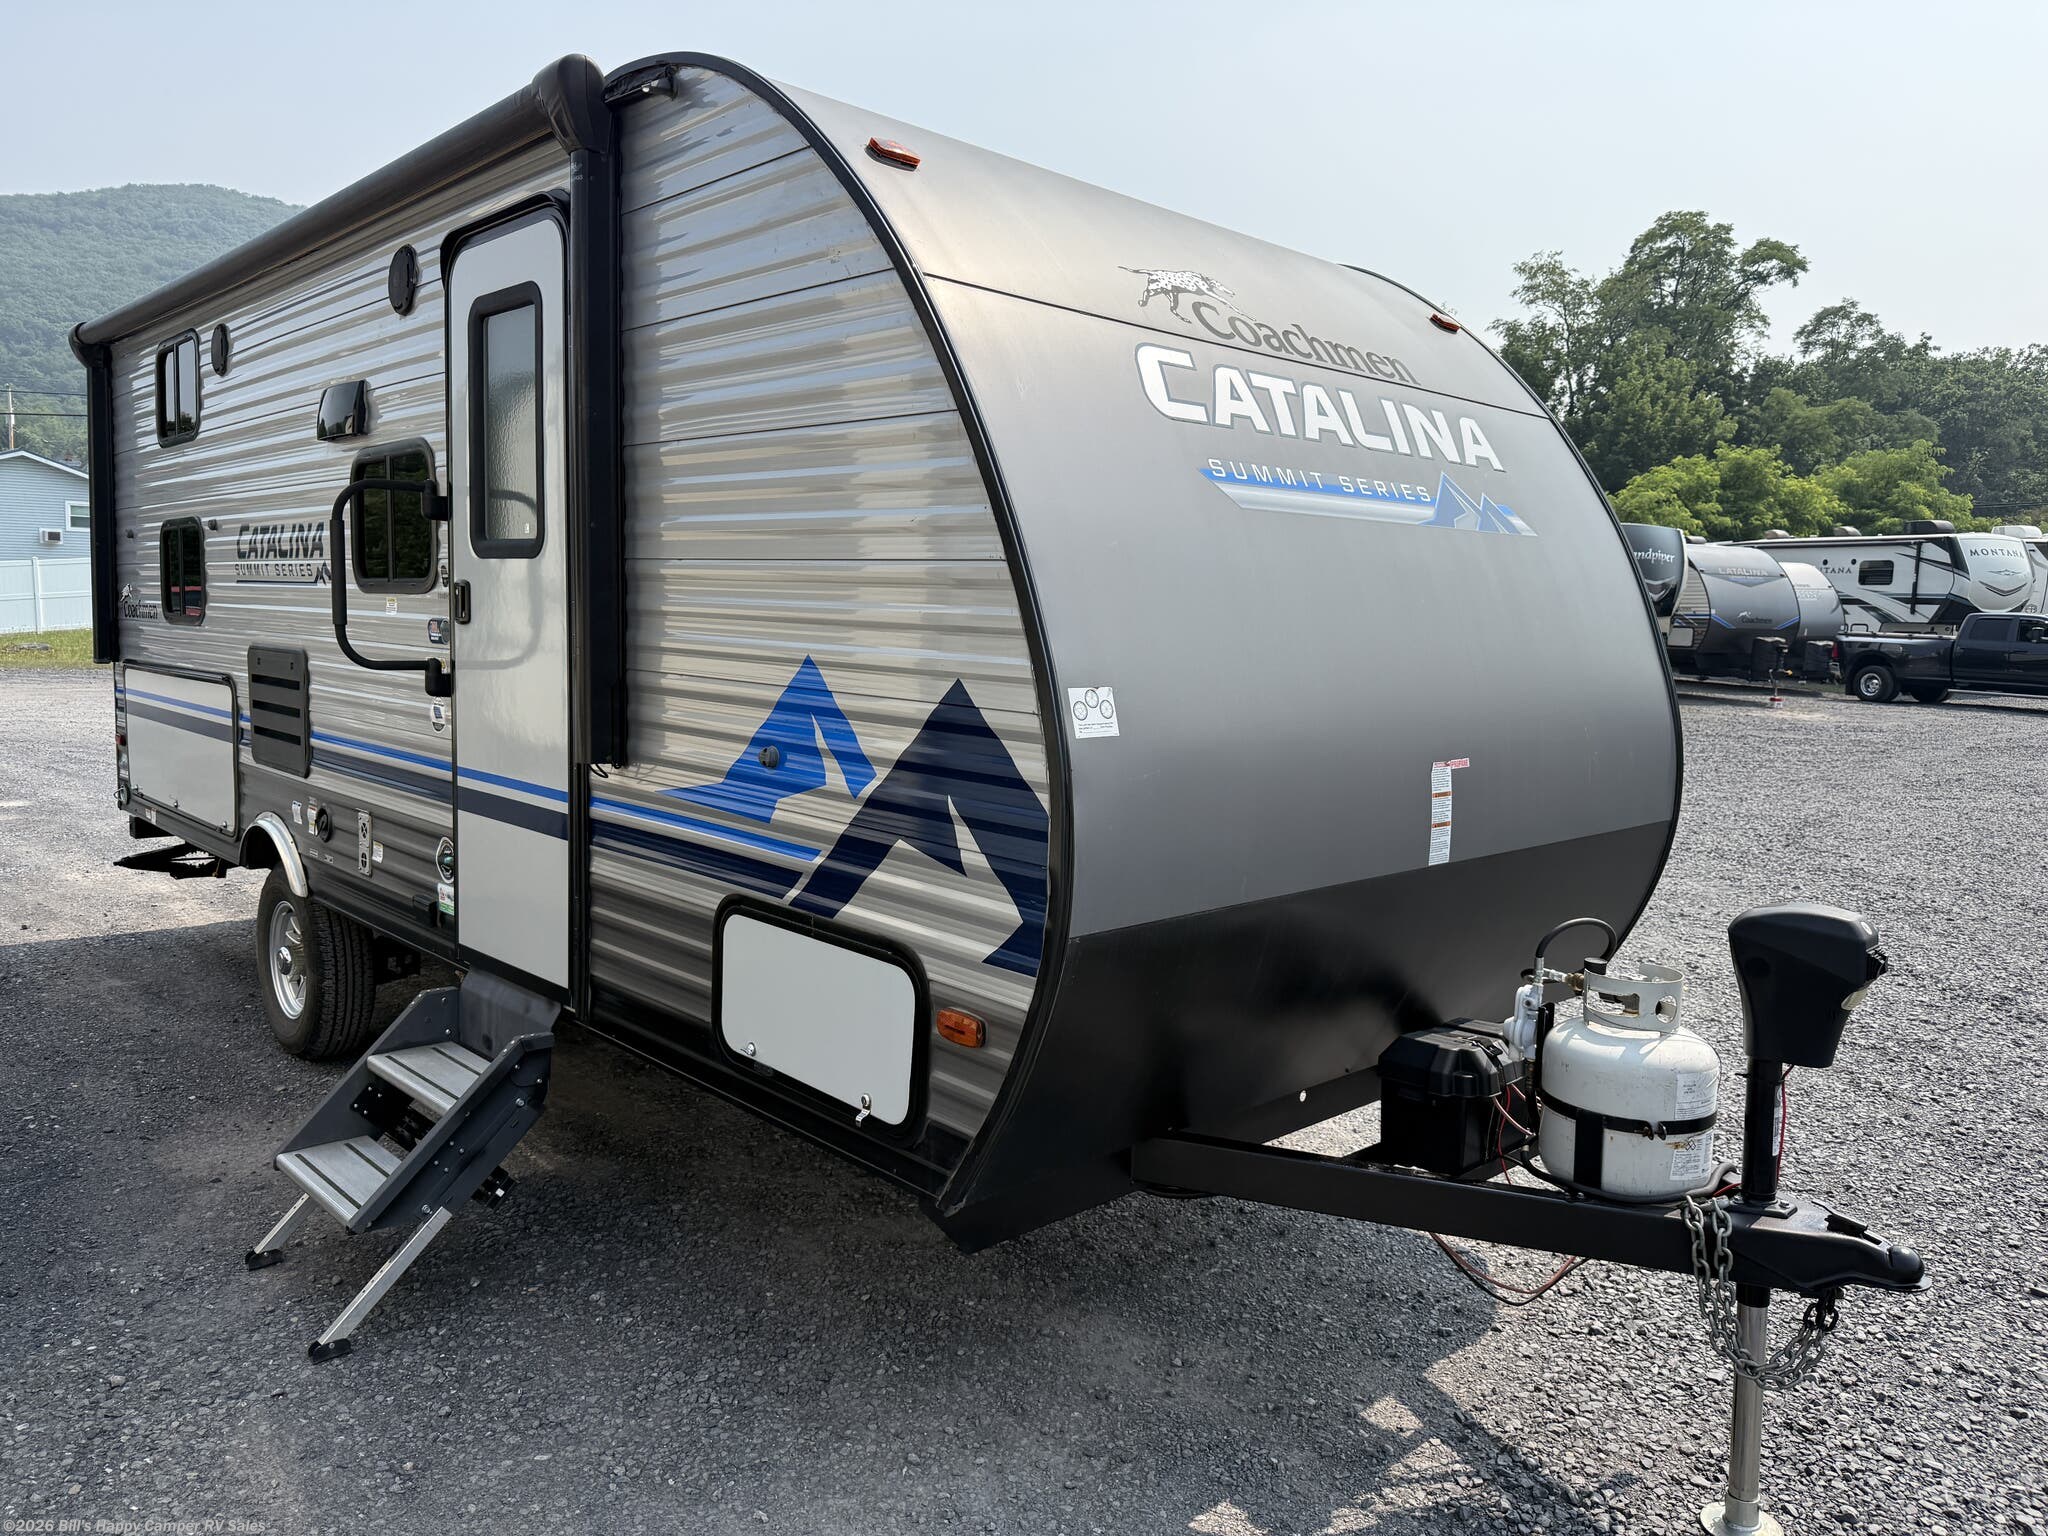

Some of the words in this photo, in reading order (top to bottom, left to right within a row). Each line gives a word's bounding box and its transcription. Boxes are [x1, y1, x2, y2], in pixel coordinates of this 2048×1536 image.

[1191, 300, 1422, 385] Coachmen
[1135, 342, 1507, 472] CATALINA
[1207, 458, 1324, 489] SUMMIT
[1338, 475, 1432, 502] SERIES
[236, 521, 325, 559] CATALINA
[1969, 548, 2025, 559] MONTANA
[234, 563, 270, 577] SUMMIT
[274, 563, 313, 577] SERIES
[1633, 548, 1676, 564] andpiper
[124, 600, 158, 619] Coachmen
